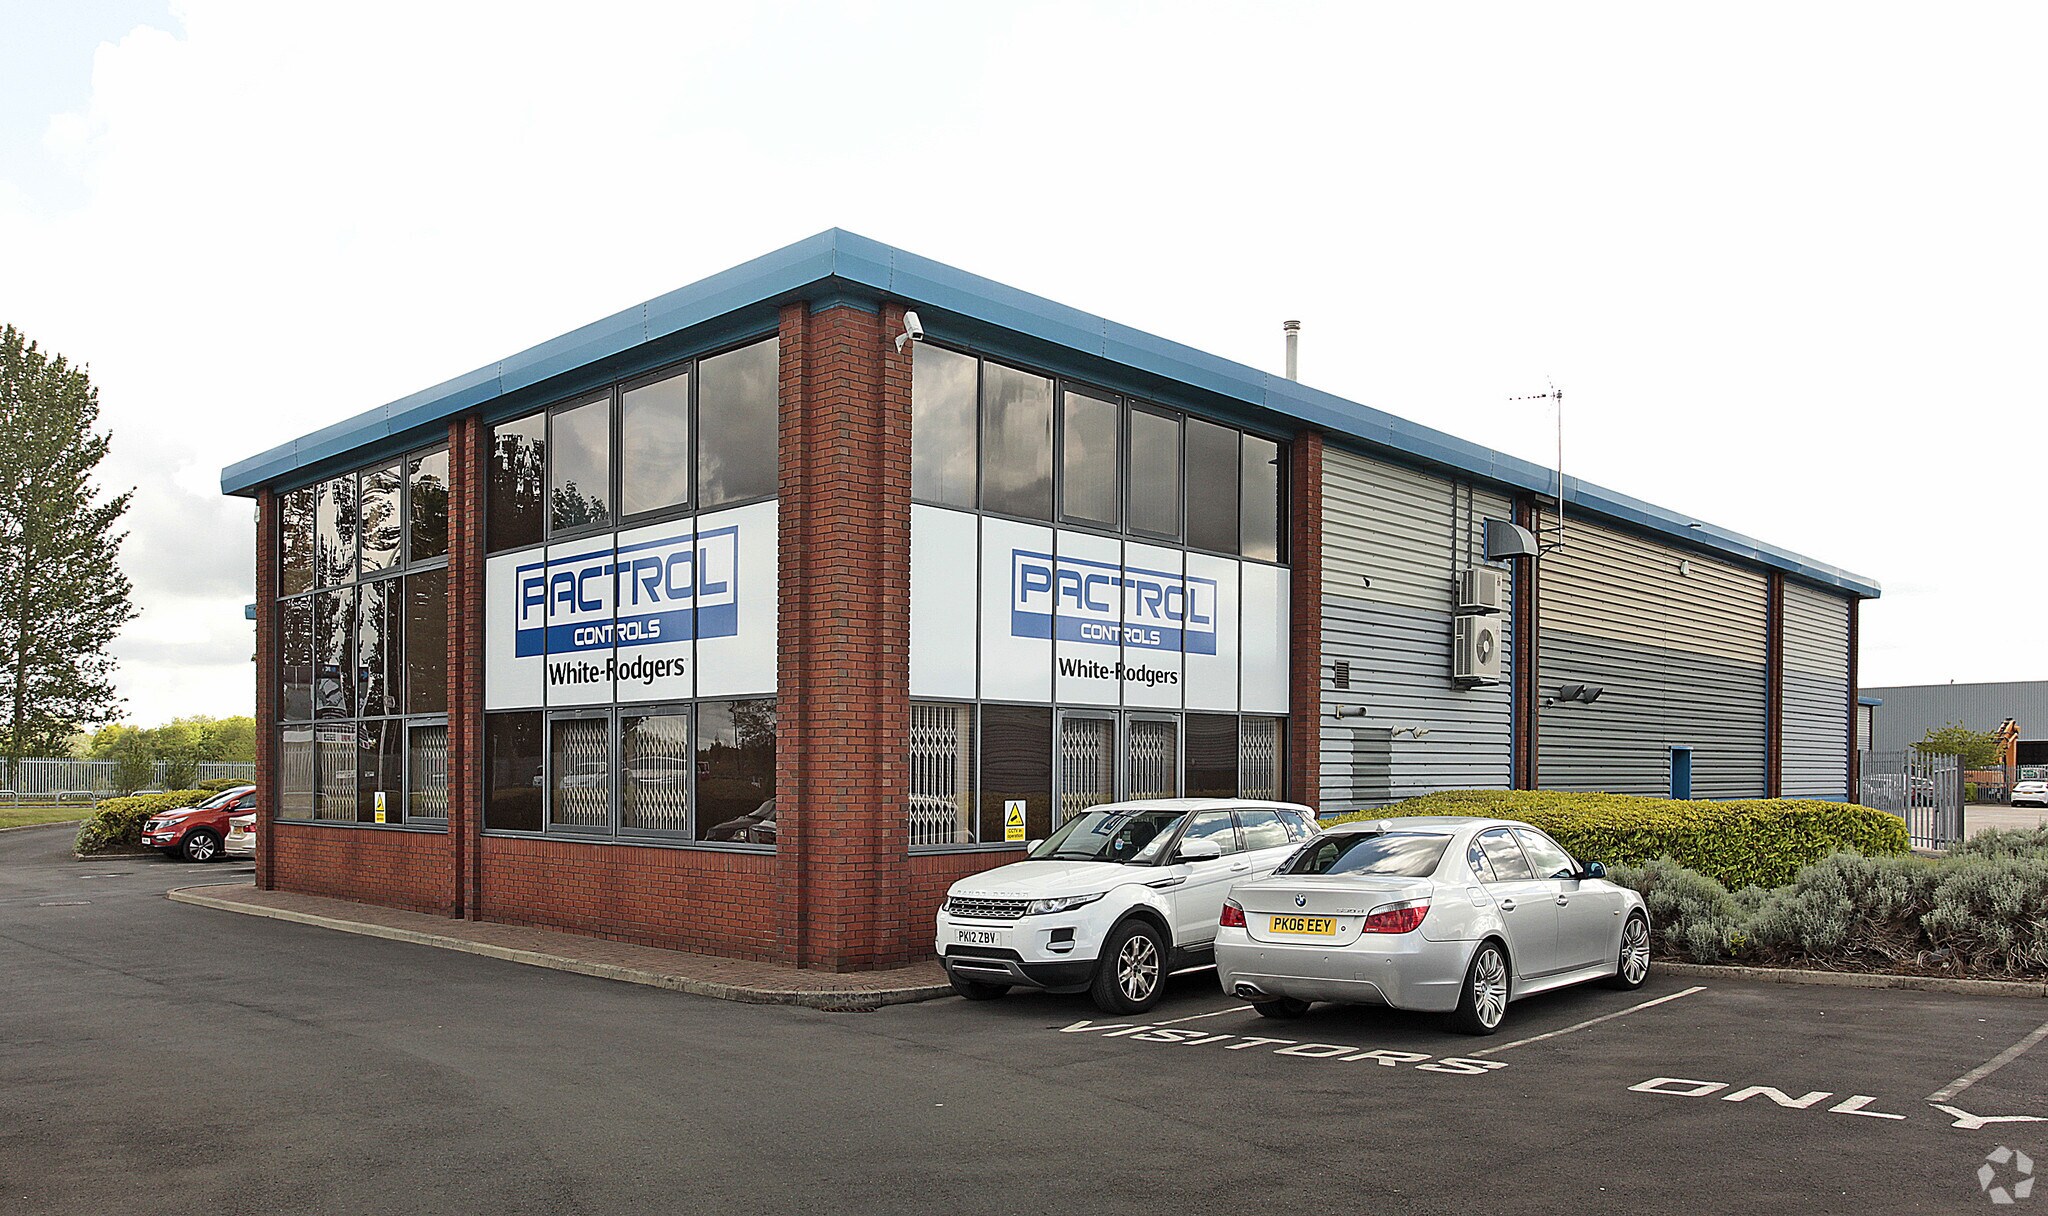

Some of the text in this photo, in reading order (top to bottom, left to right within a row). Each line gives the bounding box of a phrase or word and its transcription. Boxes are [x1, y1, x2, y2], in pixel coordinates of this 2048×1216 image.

[523, 548, 728, 620] PACTROL
[1021, 563, 1210, 625] PACTROL
[574, 619, 660, 646] CONTROLS
[1080, 623, 1161, 646] CONTROLS
[549, 655, 685, 685] White-Rodgers
[1058, 658, 1178, 687] White-Rodgers
[958, 931, 995, 944] PK12 ZBV
[1273, 918, 1331, 932] PK06 EEY
[1059, 1020, 1509, 1075] VISITORS
[1627, 1077, 2048, 1130] ONLY
